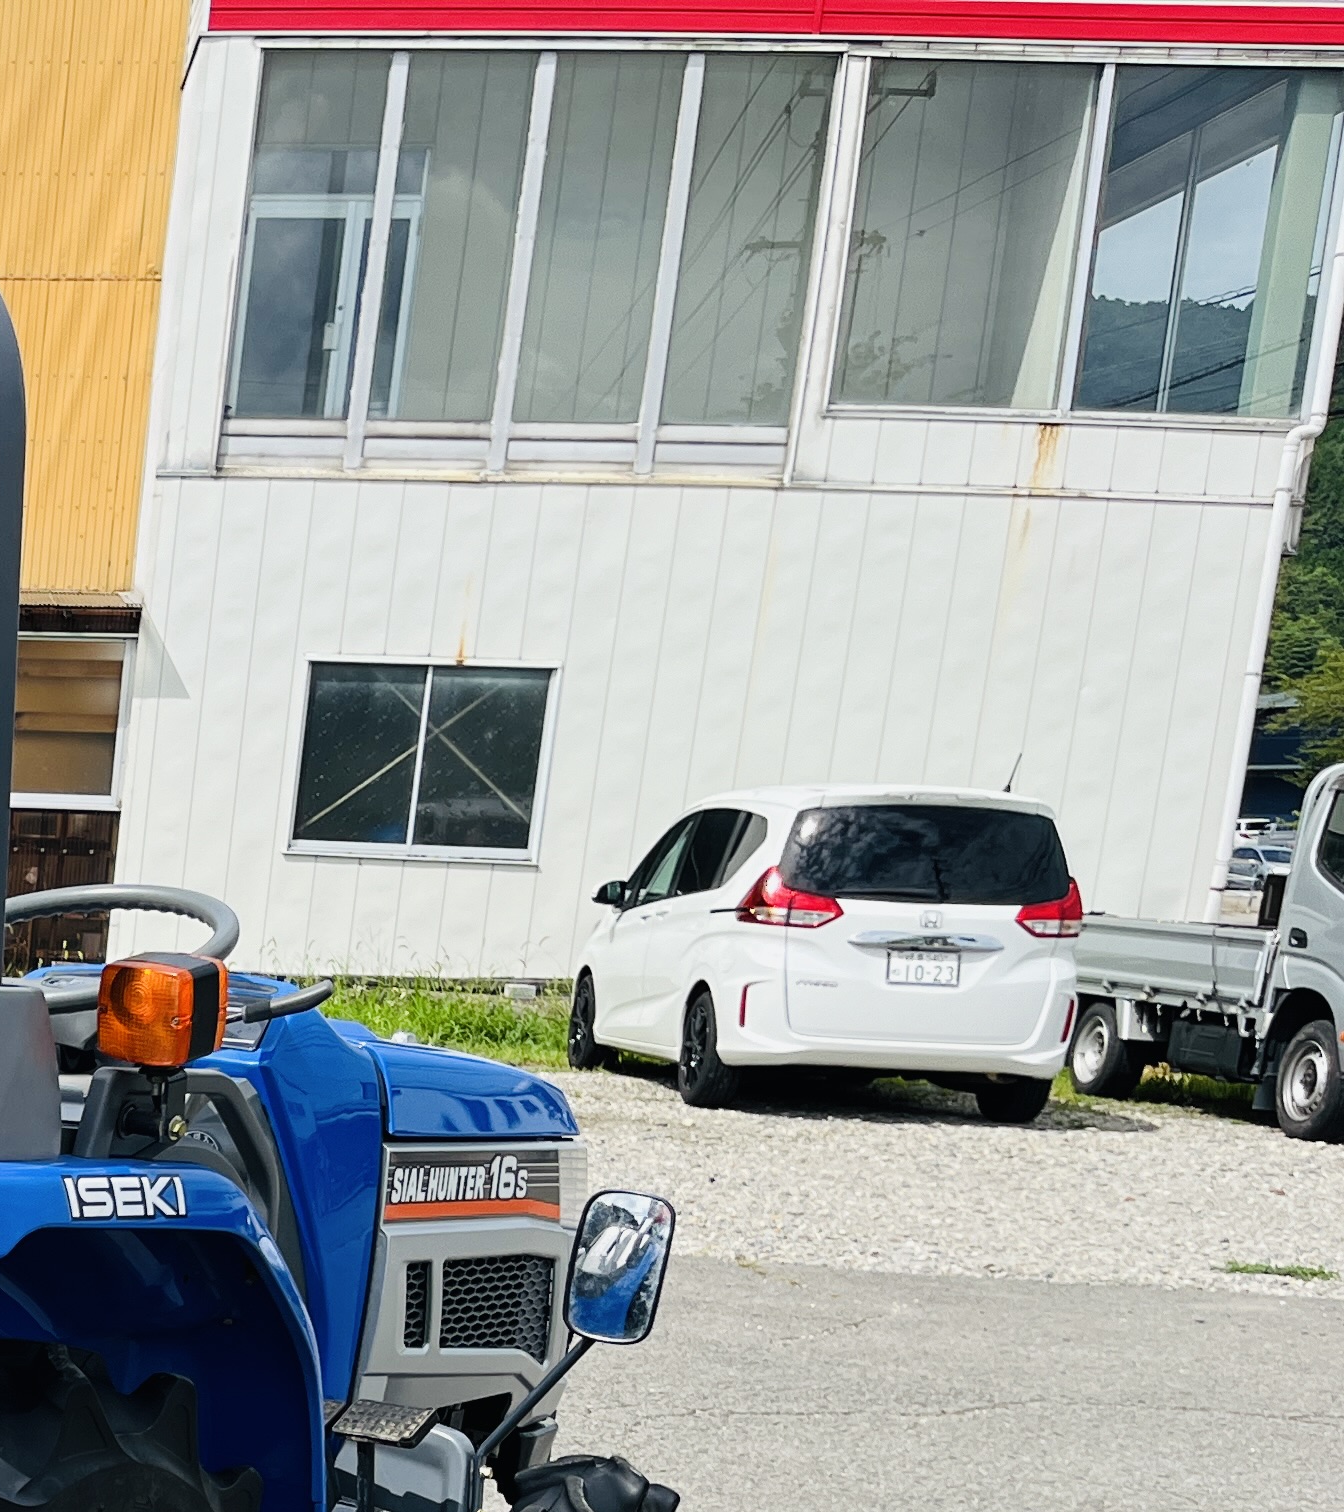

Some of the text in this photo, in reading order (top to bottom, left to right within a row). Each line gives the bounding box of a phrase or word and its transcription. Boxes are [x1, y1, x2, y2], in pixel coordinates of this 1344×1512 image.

[62, 1175, 187, 1219] ISEKI
[391, 1167, 425, 1204] SIAL
[426, 1165, 486, 1202] HUNTER
